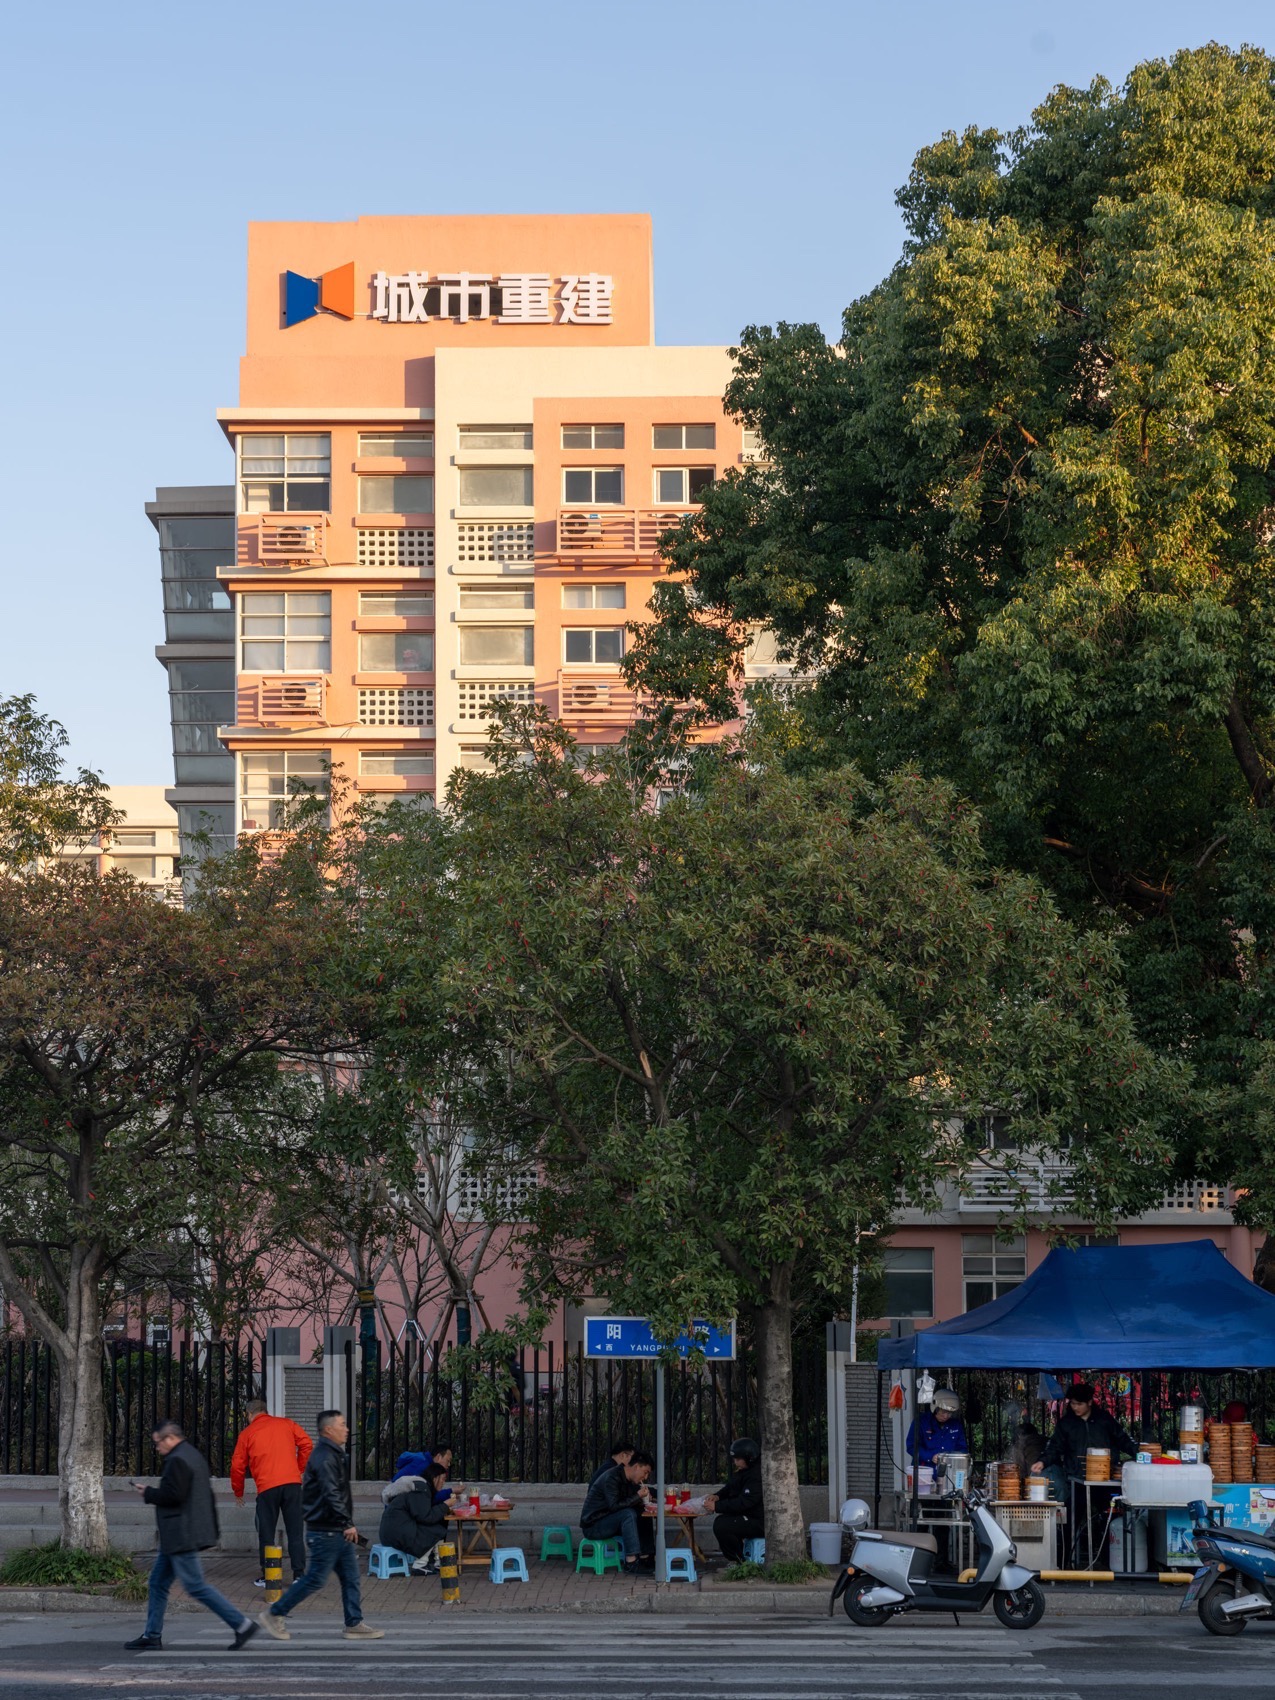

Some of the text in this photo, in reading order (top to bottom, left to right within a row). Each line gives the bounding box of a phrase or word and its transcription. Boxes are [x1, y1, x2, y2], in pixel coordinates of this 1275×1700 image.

[373, 271, 614, 324] 城市重建
[605, 1343, 613, 1352] 西
